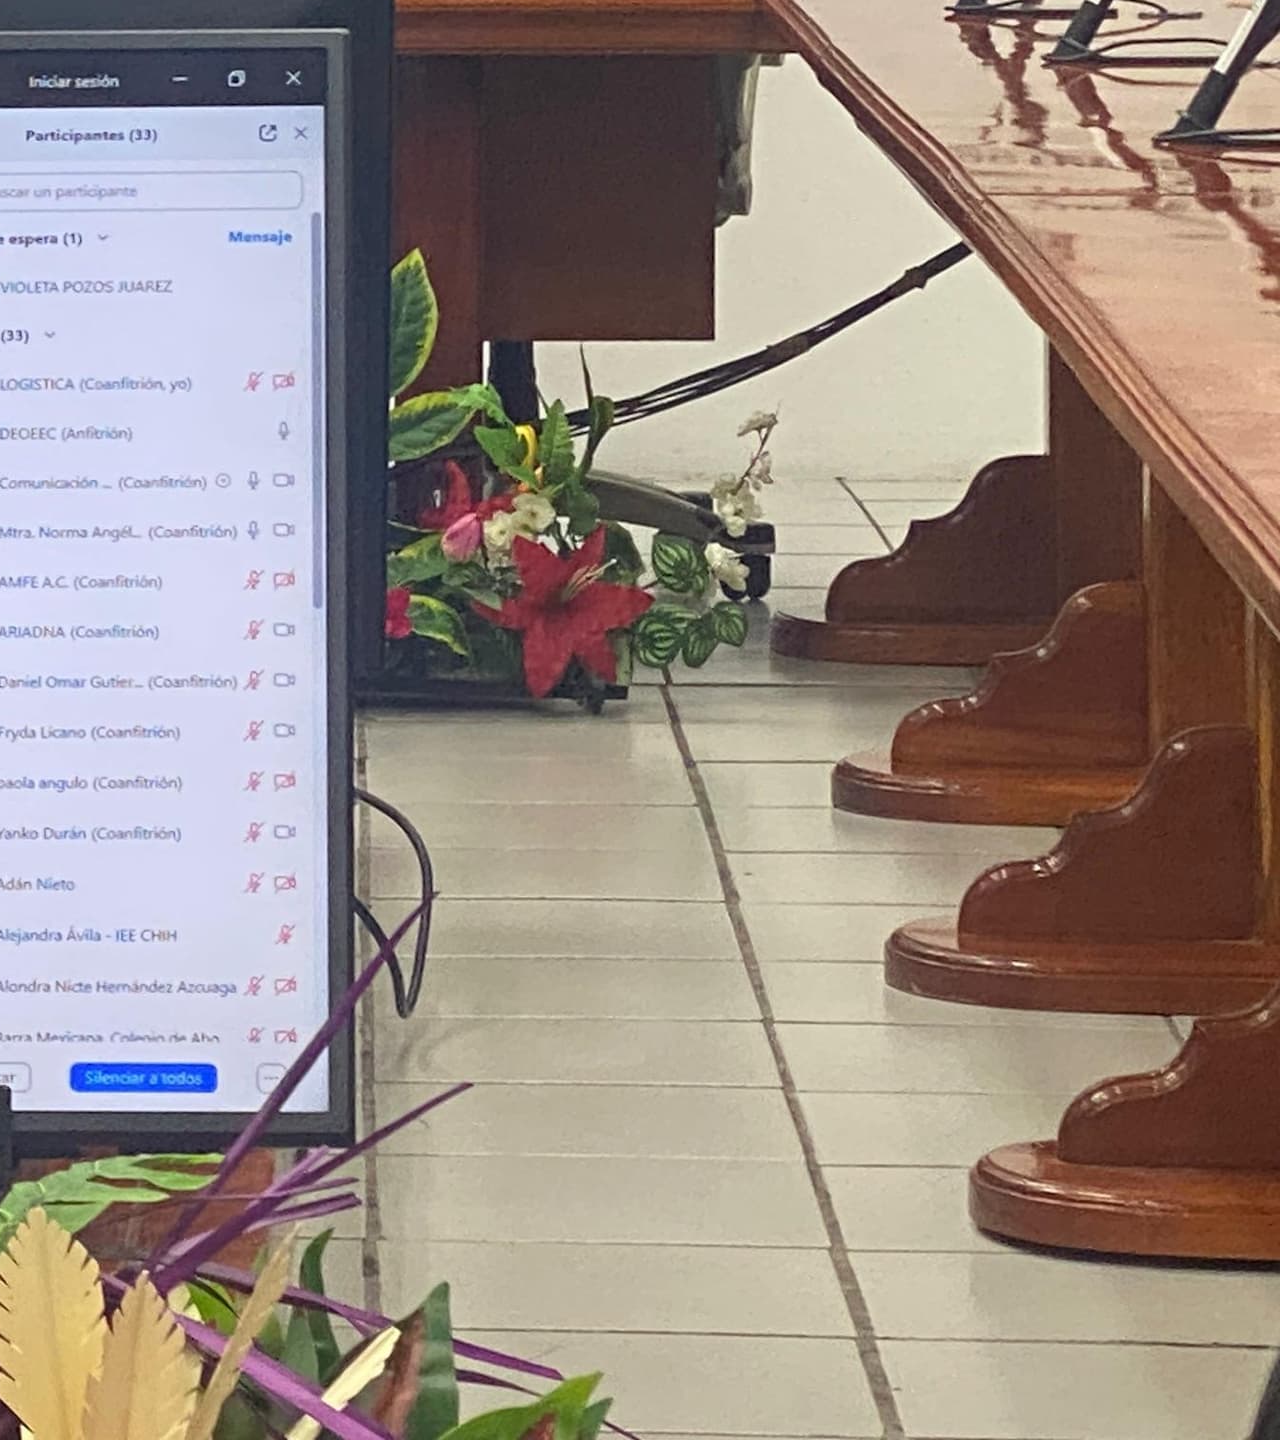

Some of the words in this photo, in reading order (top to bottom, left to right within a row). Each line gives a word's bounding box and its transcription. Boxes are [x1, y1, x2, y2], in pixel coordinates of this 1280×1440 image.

[28, 74, 71, 88] Iniciar
[74, 74, 120, 88] sesión
[25, 128, 125, 145] Participantes
[128, 127, 158, 143] (33)
[33, 187, 51, 199] un
[55, 184, 138, 202] participante
[8, 234, 59, 249] espera
[62, 231, 83, 247] (1)
[228, 230, 293, 246] Mensaje
[0, 280, 59, 294] VIOLETA
[63, 280, 114, 294] POZOS
[118, 280, 173, 294] JUAREZ
[0, 328, 30, 344] (33)
[0, 377, 75, 392] LOGISTICA
[169, 378, 193, 393] yo)
[61, 426, 133, 442] (Anfitrión)
[118, 475, 208, 492] (Coanfitrión)
[43, 826, 87, 840] Durán
[91, 826, 182, 843] (Coanfitrión)
[55, 979, 92, 994] Nicte
[96, 979, 173, 994] Hernández
[177, 979, 237, 996] Azcuaga
